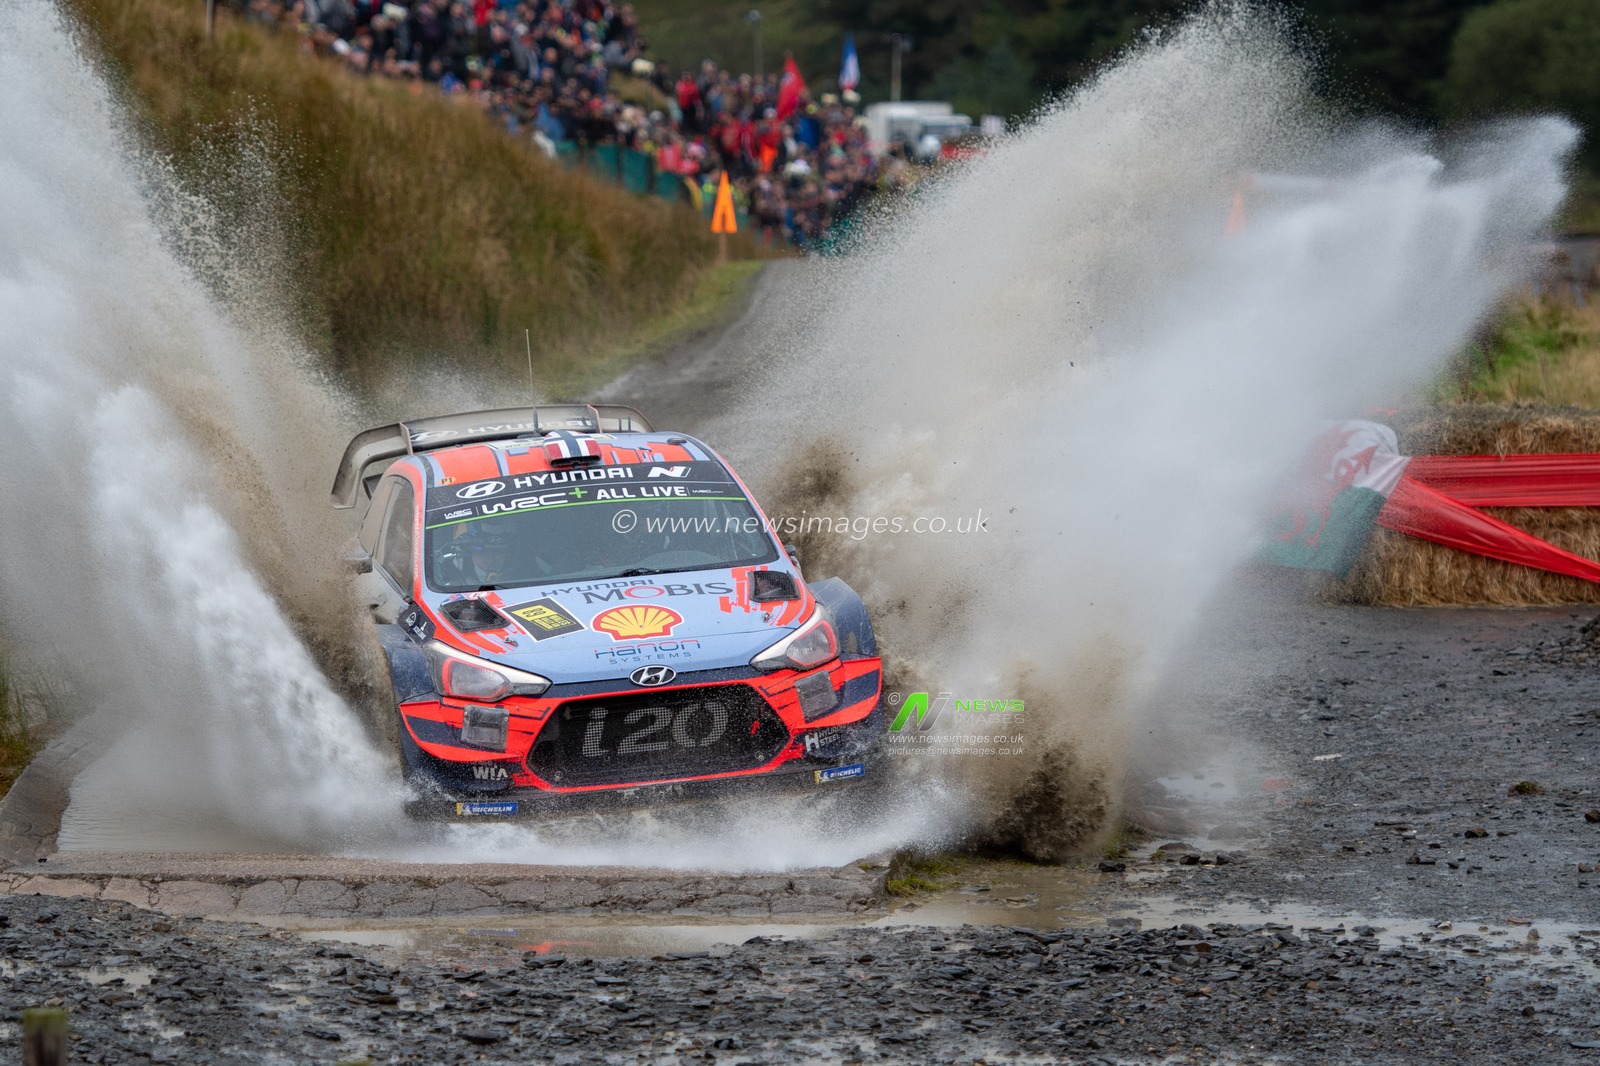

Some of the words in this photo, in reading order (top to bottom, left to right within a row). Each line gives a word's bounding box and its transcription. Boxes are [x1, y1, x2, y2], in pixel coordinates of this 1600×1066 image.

[467, 420, 593, 434] HYUNDAI
[514, 467, 633, 489] HYUNDAI
[597, 488, 636, 500] ALL
[640, 486, 688, 498] LIVE
[541, 579, 654, 597] HYUNDAI
[585, 582, 734, 604] MOBIS
[610, 651, 692, 665] SYSTEMS
[582, 701, 729, 757] i20
